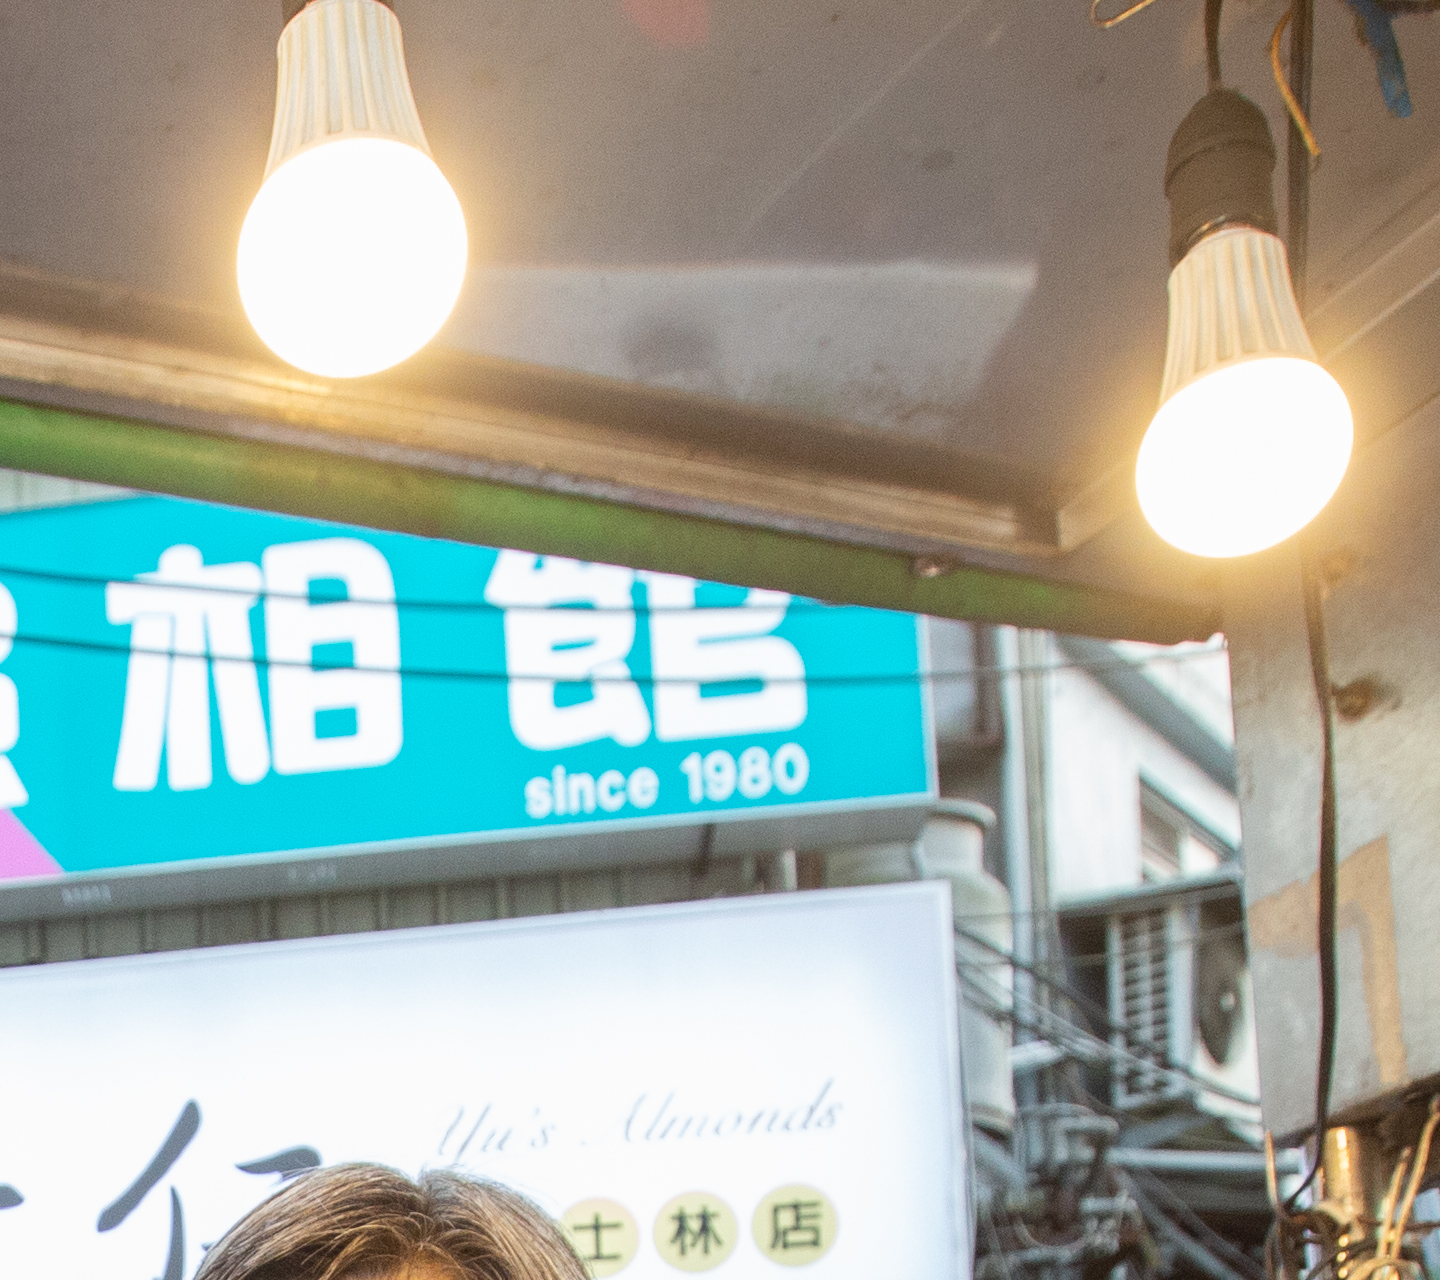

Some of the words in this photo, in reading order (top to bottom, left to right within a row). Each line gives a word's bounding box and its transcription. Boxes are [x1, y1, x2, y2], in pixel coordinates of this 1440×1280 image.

[525, 760, 657, 820] since
[679, 743, 810, 804] 1980
[572, 1198, 824, 1262] 士林店
